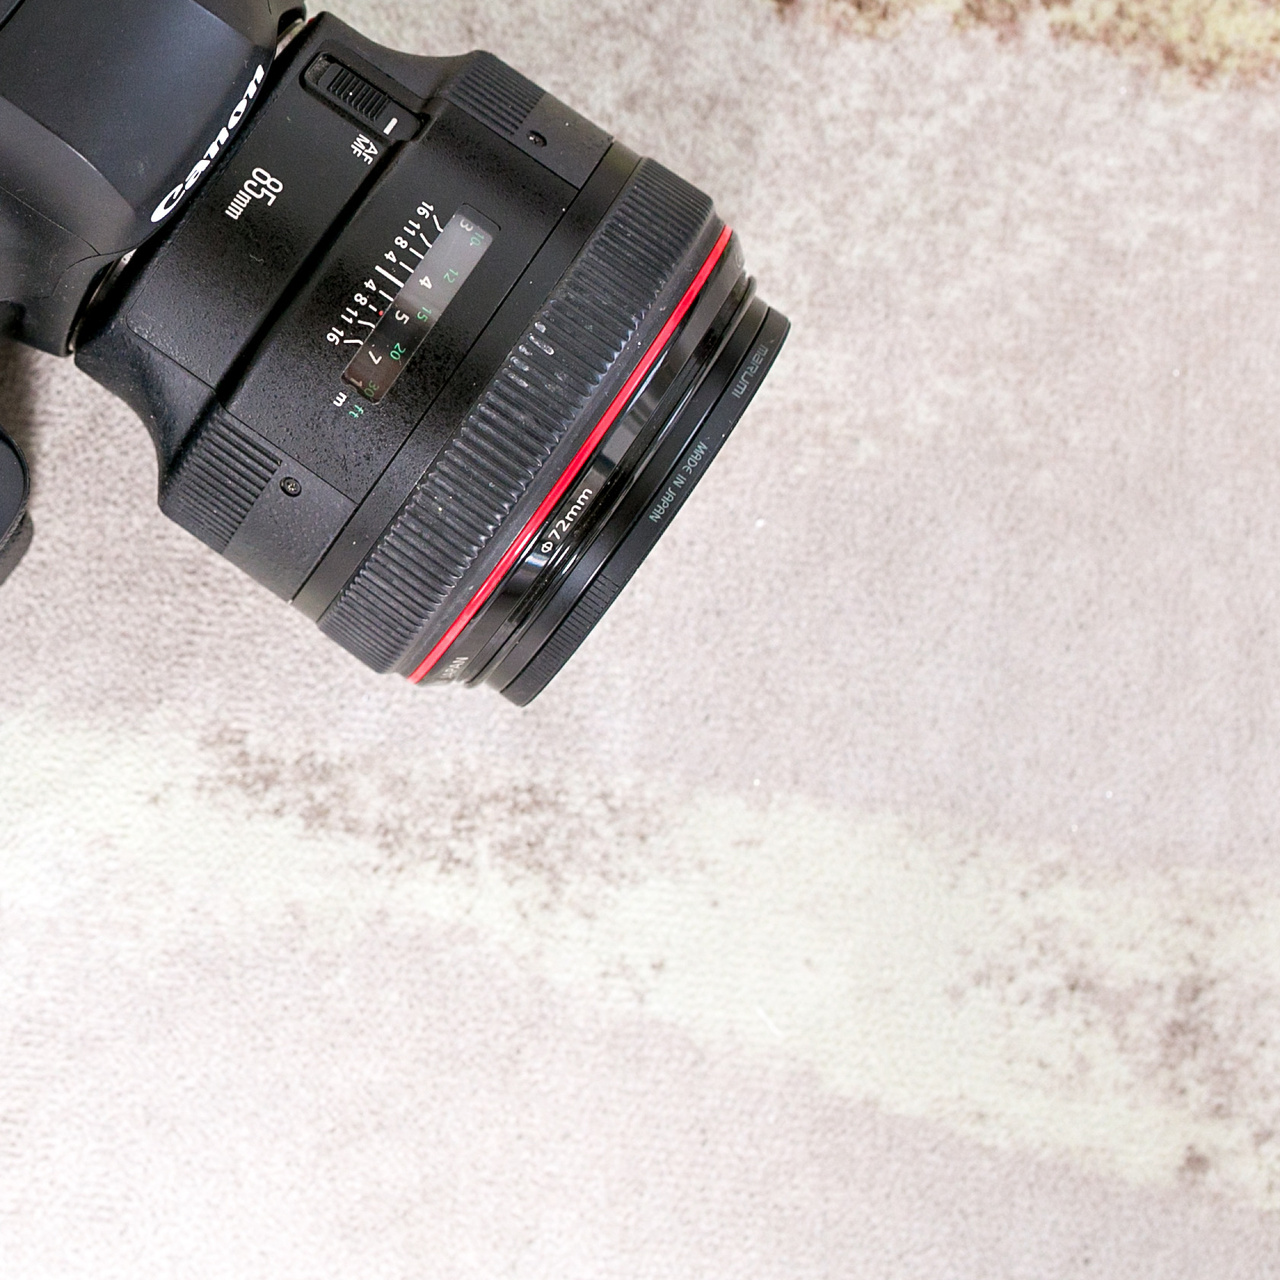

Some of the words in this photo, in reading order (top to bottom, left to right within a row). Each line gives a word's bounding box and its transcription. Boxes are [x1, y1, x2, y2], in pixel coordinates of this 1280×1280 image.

[150, 64, 265, 223] Canon
[350, 133, 370, 158] MF
[361, 140, 379, 165] AF
[416, 201, 434, 219] 16
[403, 220, 420, 237] 11
[459, 218, 474, 232] 3
[394, 236, 409, 249] 8
[469, 231, 485, 247] 10
[384, 250, 397, 263] 4
[418, 275, 433, 290] 4
[443, 269, 459, 283] 12
[364, 278, 377, 292] 4
[353, 292, 368, 306] 8
[341, 307, 358, 324] 11
[394, 310, 410, 325] 5
[416, 306, 432, 322] 15
[326, 326, 344, 345] 16
[369, 351, 382, 365] 7
[390, 342, 406, 360] 20
[363, 380, 379, 398] 30
[332, 391, 347, 408] m
[349, 404, 364, 418] ft
[688, 440, 708, 475] MADE
[673, 475, 687, 489] IN
[649, 486, 677, 523] JAPAN
